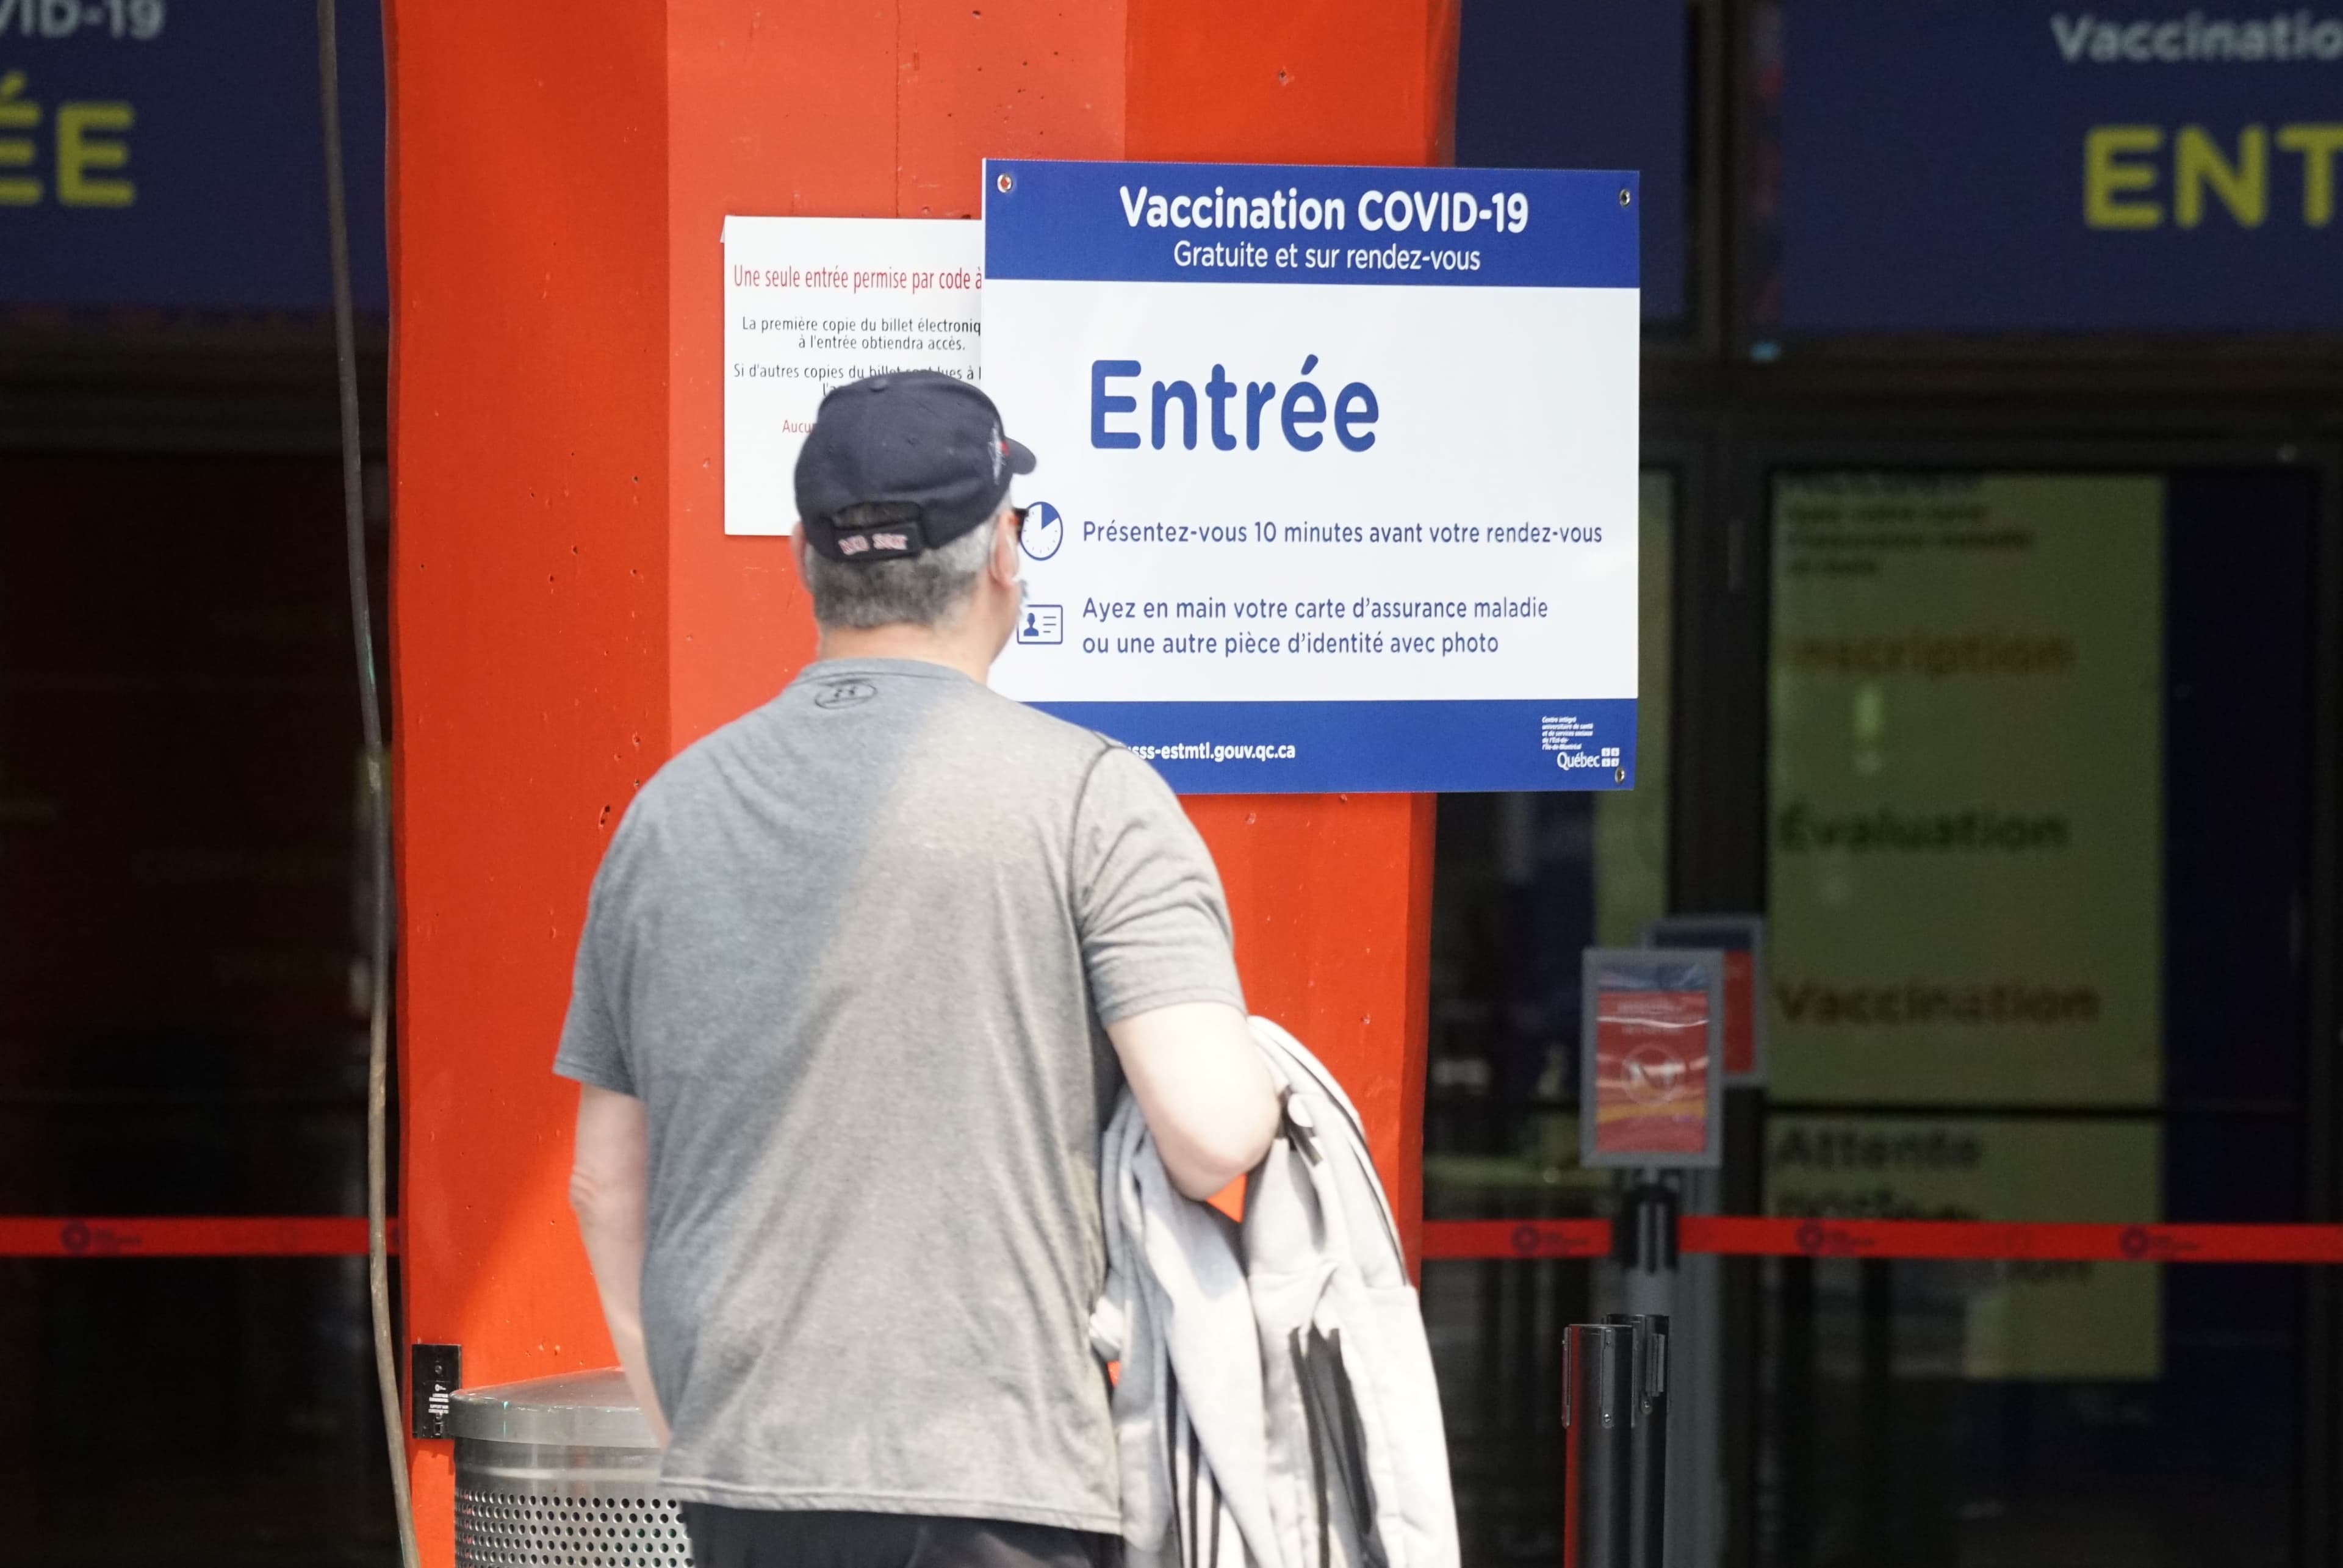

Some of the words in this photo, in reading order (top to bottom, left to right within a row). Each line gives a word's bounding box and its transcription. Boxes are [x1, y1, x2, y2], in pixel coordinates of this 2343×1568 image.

[2084, 124, 2343, 231] ENT
[1119, 185, 1345, 230] Vaccination
[1358, 190, 1528, 233] COVID-19
[1174, 240, 1269, 268] Gratuite
[1275, 243, 1298, 268] et
[1305, 248, 1340, 269] sur
[1347, 243, 1480, 270] rendez-vous
[734, 265, 761, 287] Une
[765, 265, 801, 287] seule
[805, 265, 849, 289] entrée
[854, 267, 907, 294] permise
[912, 272, 935, 295] par
[939, 267, 971, 290] code
[975, 266, 982, 290] à
[743, 317, 757, 331] La
[761, 317, 818, 334] première
[822, 318, 857, 334] copie
[861, 318, 877, 332] du
[882, 318, 913, 332] billet
[799, 334, 806, 349] à
[810, 336, 857, 350] l'entrée
[862, 336, 924, 350] obtiendra
[927, 336, 966, 351] accès.
[734, 364, 744, 378] Si
[749, 364, 800, 378] d'autres
[804, 365, 844, 381] copies
[849, 365, 865, 379] du
[967, 365, 974, 380] à
[1090, 353, 1379, 453] Entrée
[782, 420, 812, 434] Aucu
[1084, 519, 1247, 543] Présentez-vous
[1254, 521, 1276, 543] 10
[1284, 521, 1363, 543] minutes
[1369, 523, 1422, 543] avant
[1429, 523, 1480, 543] votre
[1487, 522, 1602, 543] rendez-vous
[1082, 597, 1136, 623] Ayez
[1143, 602, 1168, 619] en
[1176, 597, 1226, 619] main
[1234, 599, 1287, 619] votre
[1295, 599, 1345, 619] carte
[1353, 597, 1467, 619] d’assurance
[1474, 597, 1548, 619] maladie
[1082, 637, 1109, 653] ou
[1117, 637, 1155, 653] une
[1162, 633, 1217, 653] autre
[1225, 631, 1280, 658] pièce
[1288, 631, 1383, 654] d’identité
[1391, 636, 1435, 653] avec
[1442, 631, 1499, 658] photo
[1557, 751, 1600, 771] Québec
